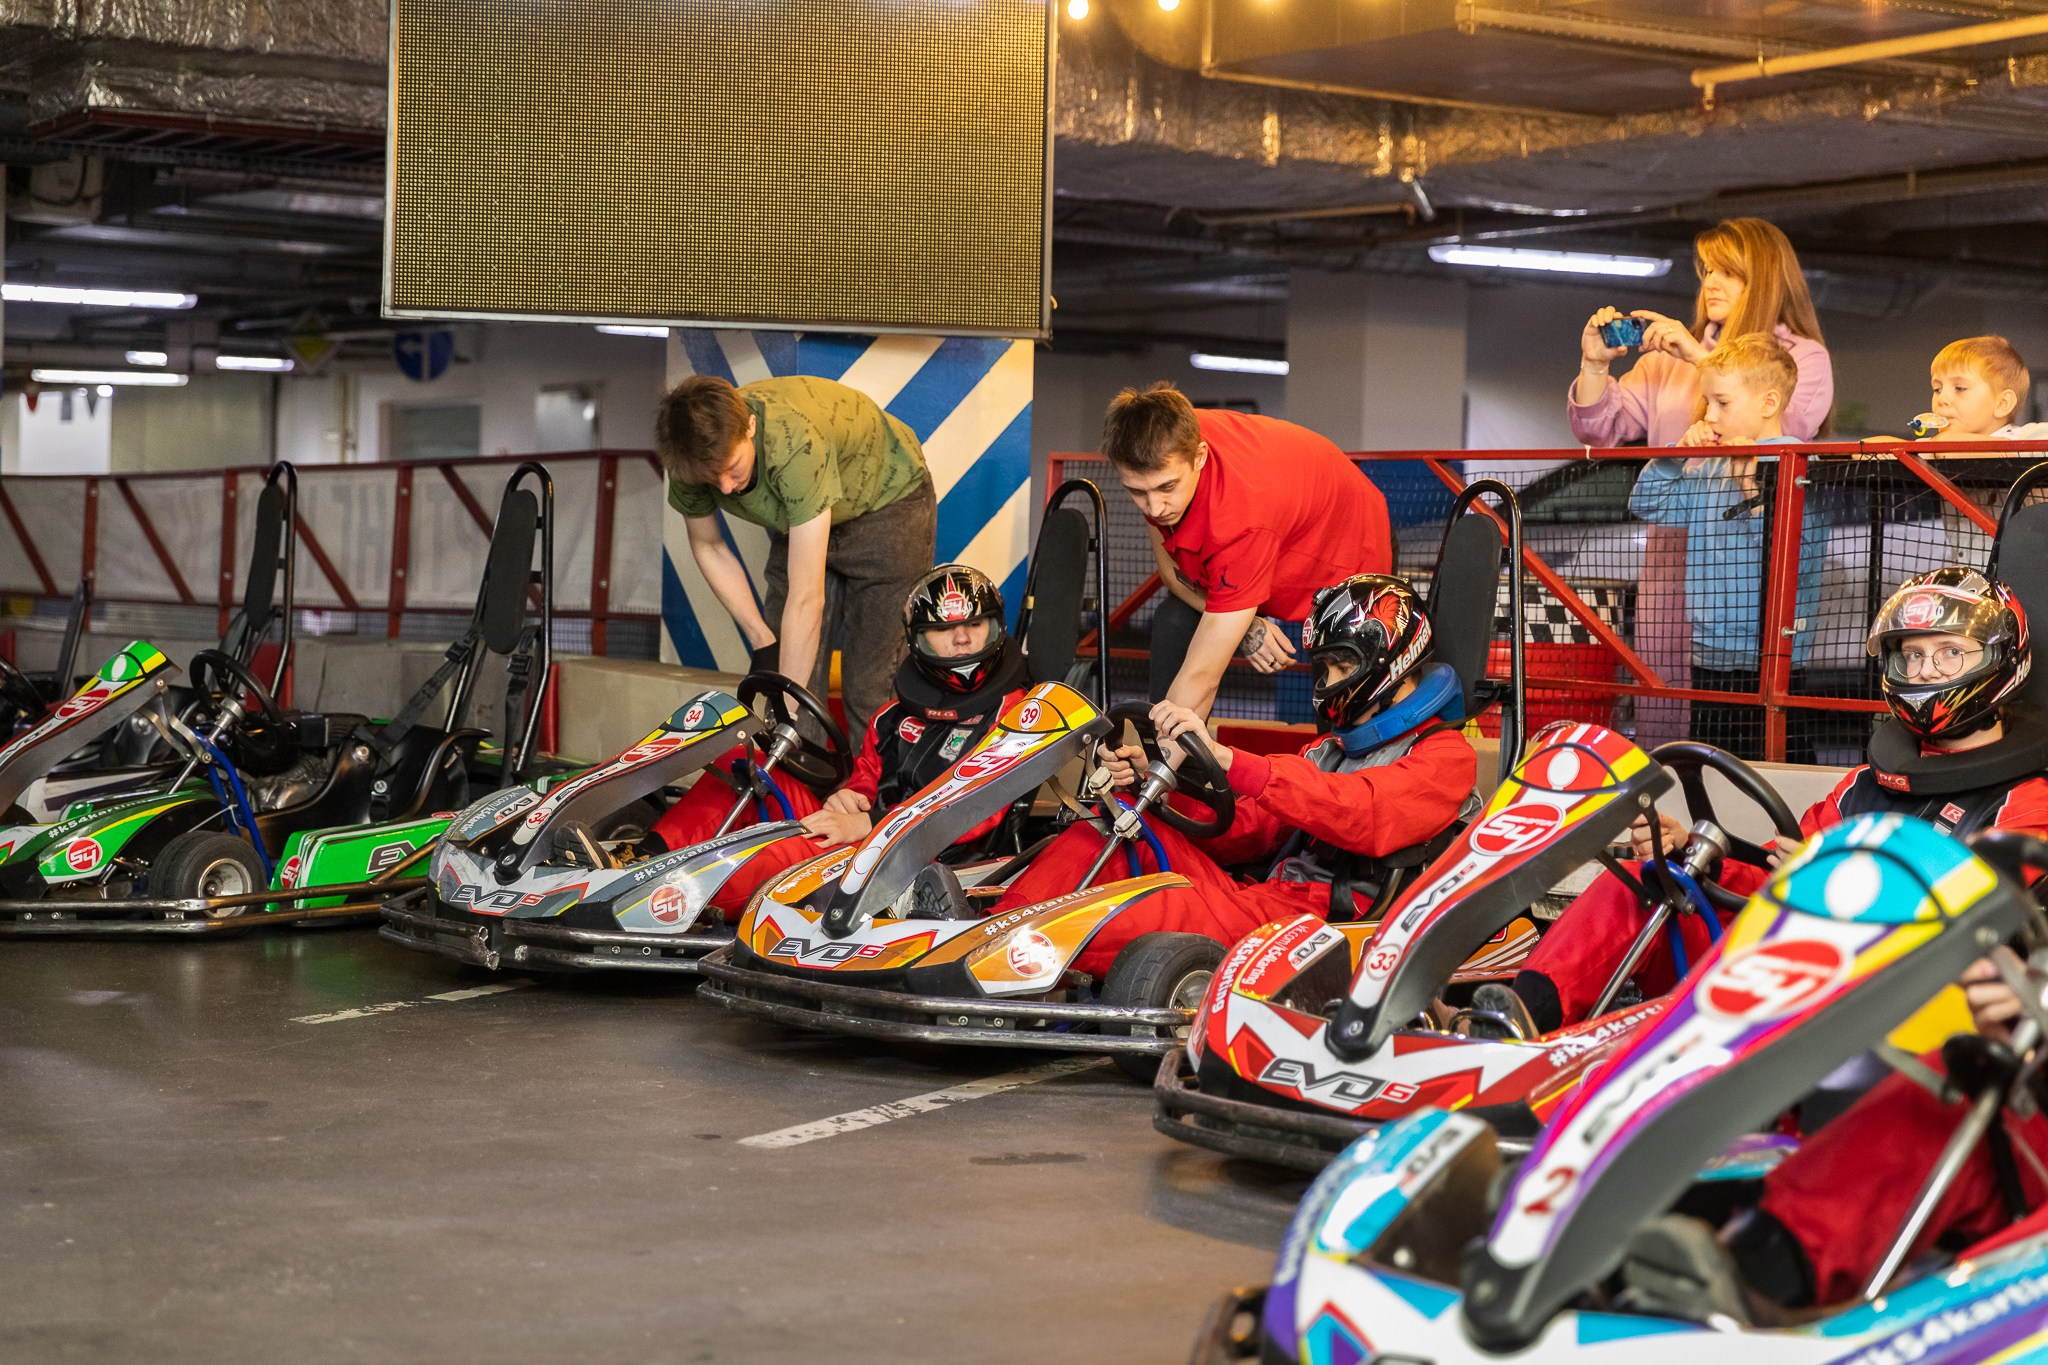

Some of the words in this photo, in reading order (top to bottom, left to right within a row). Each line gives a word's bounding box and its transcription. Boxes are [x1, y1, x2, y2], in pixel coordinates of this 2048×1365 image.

[685, 710, 702, 723] 34
[1020, 708, 1039, 724] 39
[528, 811, 549, 825] 34
[1370, 951, 1395, 972] 33
[1524, 1167, 1578, 1215] 2
